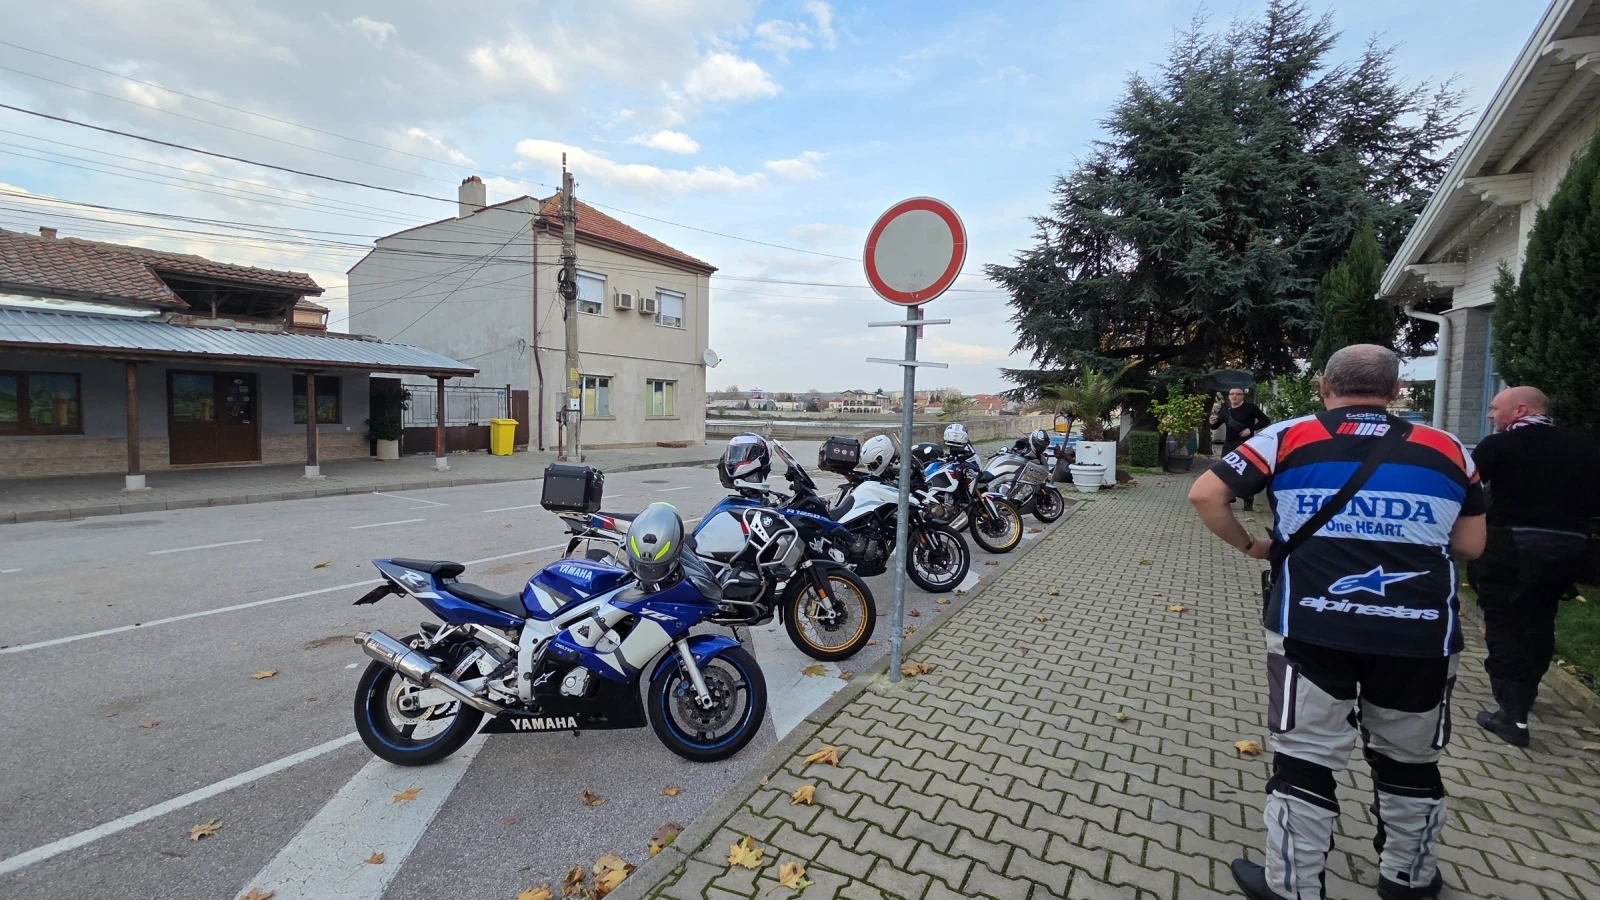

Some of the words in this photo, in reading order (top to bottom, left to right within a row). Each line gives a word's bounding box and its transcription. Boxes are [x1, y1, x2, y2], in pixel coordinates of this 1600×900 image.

[1325, 519, 1353, 533] One
[1355, 520, 1406, 538] HEART.
[558, 564, 593, 581] YAMAHA
[1298, 595, 1440, 621] alpinestars
[510, 716, 578, 731] YAMAHA
